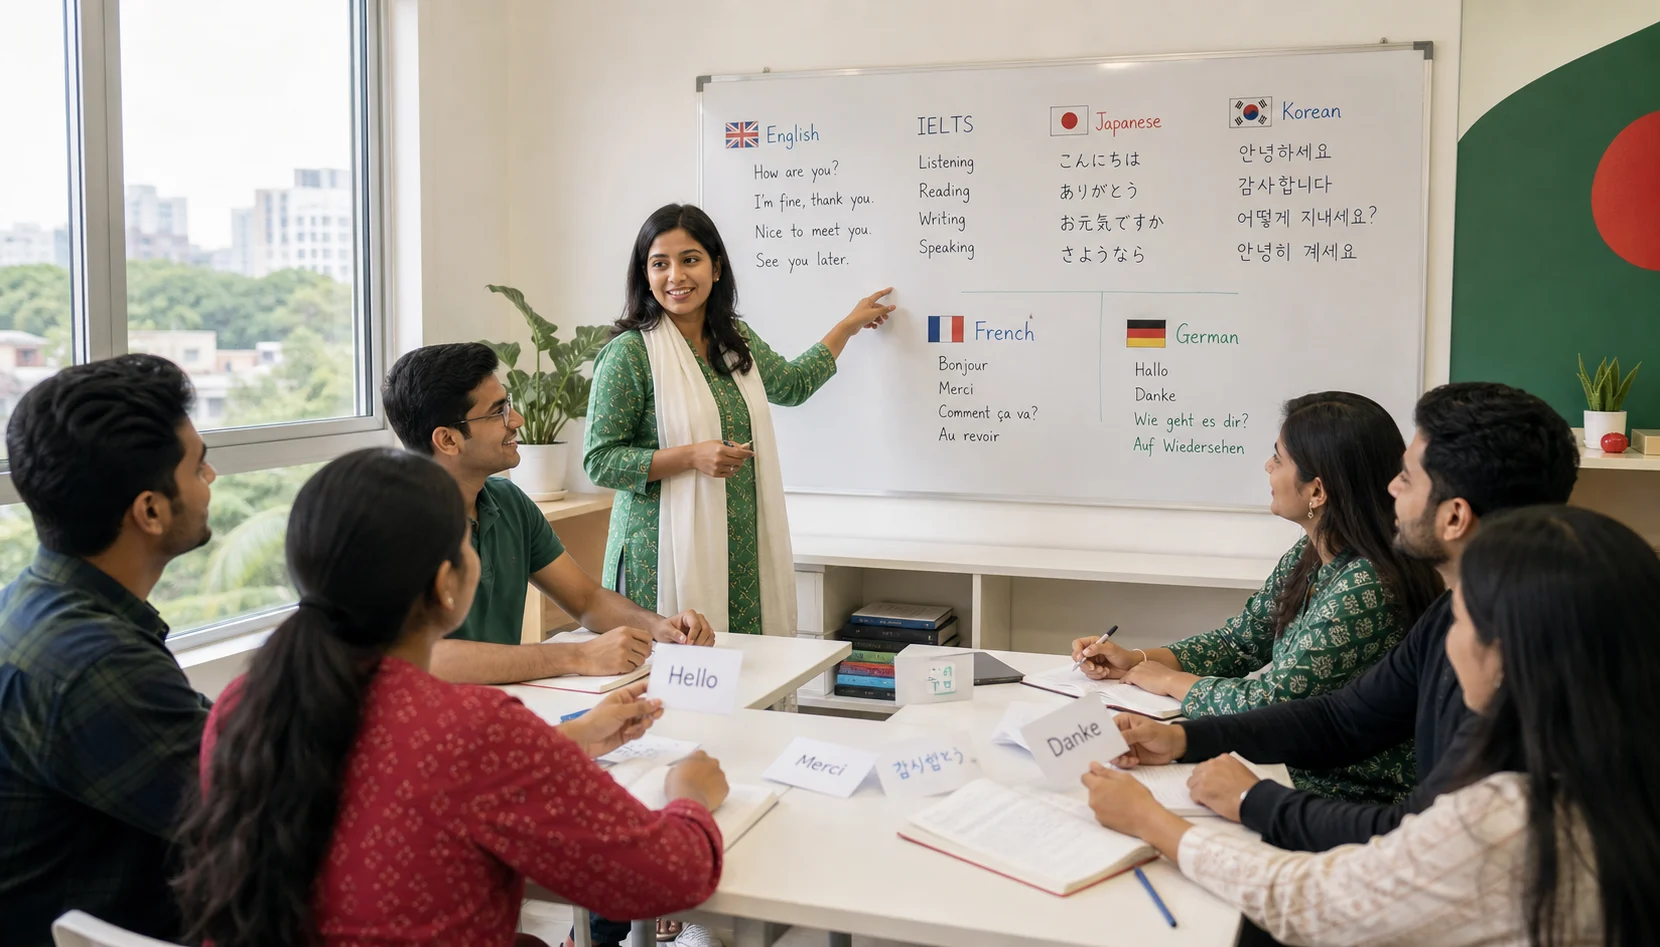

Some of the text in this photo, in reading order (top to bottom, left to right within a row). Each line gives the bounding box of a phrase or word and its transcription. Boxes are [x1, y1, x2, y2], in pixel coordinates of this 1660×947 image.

[1283, 101, 1341, 120] Korean
[918, 115, 973, 135] IELTS
[1096, 112, 1161, 137] Japanese
[767, 123, 819, 150] English
[1060, 152, 1140, 168] こんにちは
[1239, 143, 1331, 163] 안녕하세요
[754, 160, 839, 183] How are you?
[919, 154, 974, 174] Listening
[919, 182, 970, 203] Reading
[1060, 182, 1137, 200] ありがとう
[1239, 175, 1332, 196] 감사합니다
[754, 192, 874, 212] I'm fine, thank you.
[919, 211, 965, 232] Writing
[1061, 213, 1164, 231] お元気ですか
[1238, 205, 1377, 228] 어떻게 지내세요?
[756, 223, 872, 242] Nice to meet you.
[919, 239, 974, 260] Speaking
[1062, 246, 1144, 263] さようなら
[1237, 242, 1357, 262] 안녕히 계세요
[756, 251, 849, 274] See you later.
[976, 321, 1034, 341] French
[1176, 323, 1239, 344] German
[939, 356, 988, 376] Bonjour
[1136, 362, 1168, 376] Hallo
[939, 381, 973, 395] Merci
[1135, 387, 1176, 402] Danke
[939, 404, 1038, 422] Comment ça va?
[1134, 412, 1248, 433] Wie geht es dir?
[939, 427, 999, 442] Au revoir
[1133, 437, 1244, 457] Auf Wiedersehen
[669, 665, 718, 689] Hello
[1046, 722, 1102, 758] Danke
[795, 753, 848, 777] Merci
